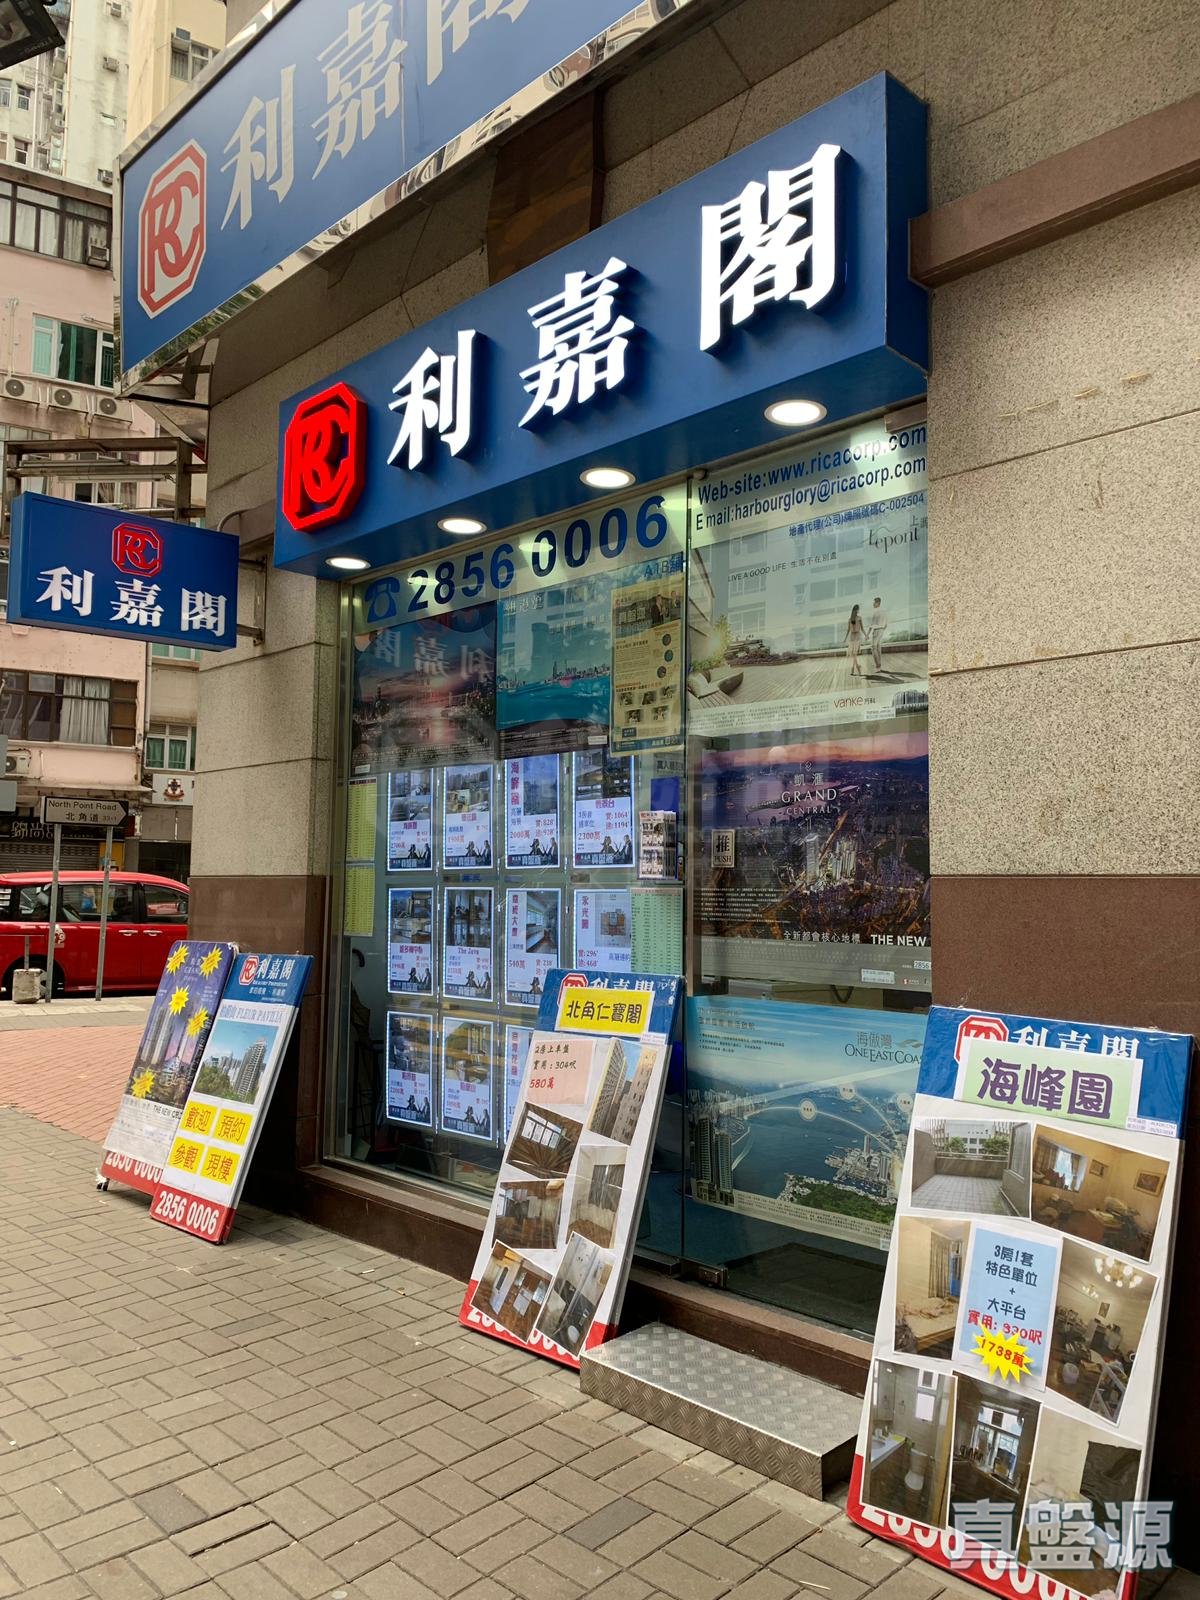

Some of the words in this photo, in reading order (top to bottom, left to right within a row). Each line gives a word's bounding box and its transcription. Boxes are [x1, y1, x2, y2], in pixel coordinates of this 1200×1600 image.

[387, 143, 842, 470] 利嘉閣
[407, 543, 515, 612] 2856
[532, 495, 668, 578] 0006
[36, 565, 228, 637] 利嘉閣
[833, 695, 864, 709] vanke
[48, 800, 71, 808] North
[73, 801, 93, 809] Point
[96, 803, 117, 811] Road
[781, 788, 837, 804] GRAND
[65, 812, 98, 822] 北角道
[786, 806, 832, 816] CENTRAL
[716, 835, 730, 852] 推
[714, 855, 732, 863] PUSH
[870, 934, 894, 946] THE
[896, 935, 927, 947] NEW
[255, 958, 295, 981] 利嘉閣
[894, 1050, 922, 1065] COA
[977, 1056, 1114, 1120] 海峰園
[218, 1115, 246, 1142] 預約
[206, 1153, 234, 1182] 現樓
[154, 1190, 188, 1223] 2856
[186, 1201, 220, 1235] 0006
[985, 1260, 1038, 1287] 特色單位
[987, 1297, 1027, 1321] 大平台
[981, 1338, 1025, 1368] 1738萬
